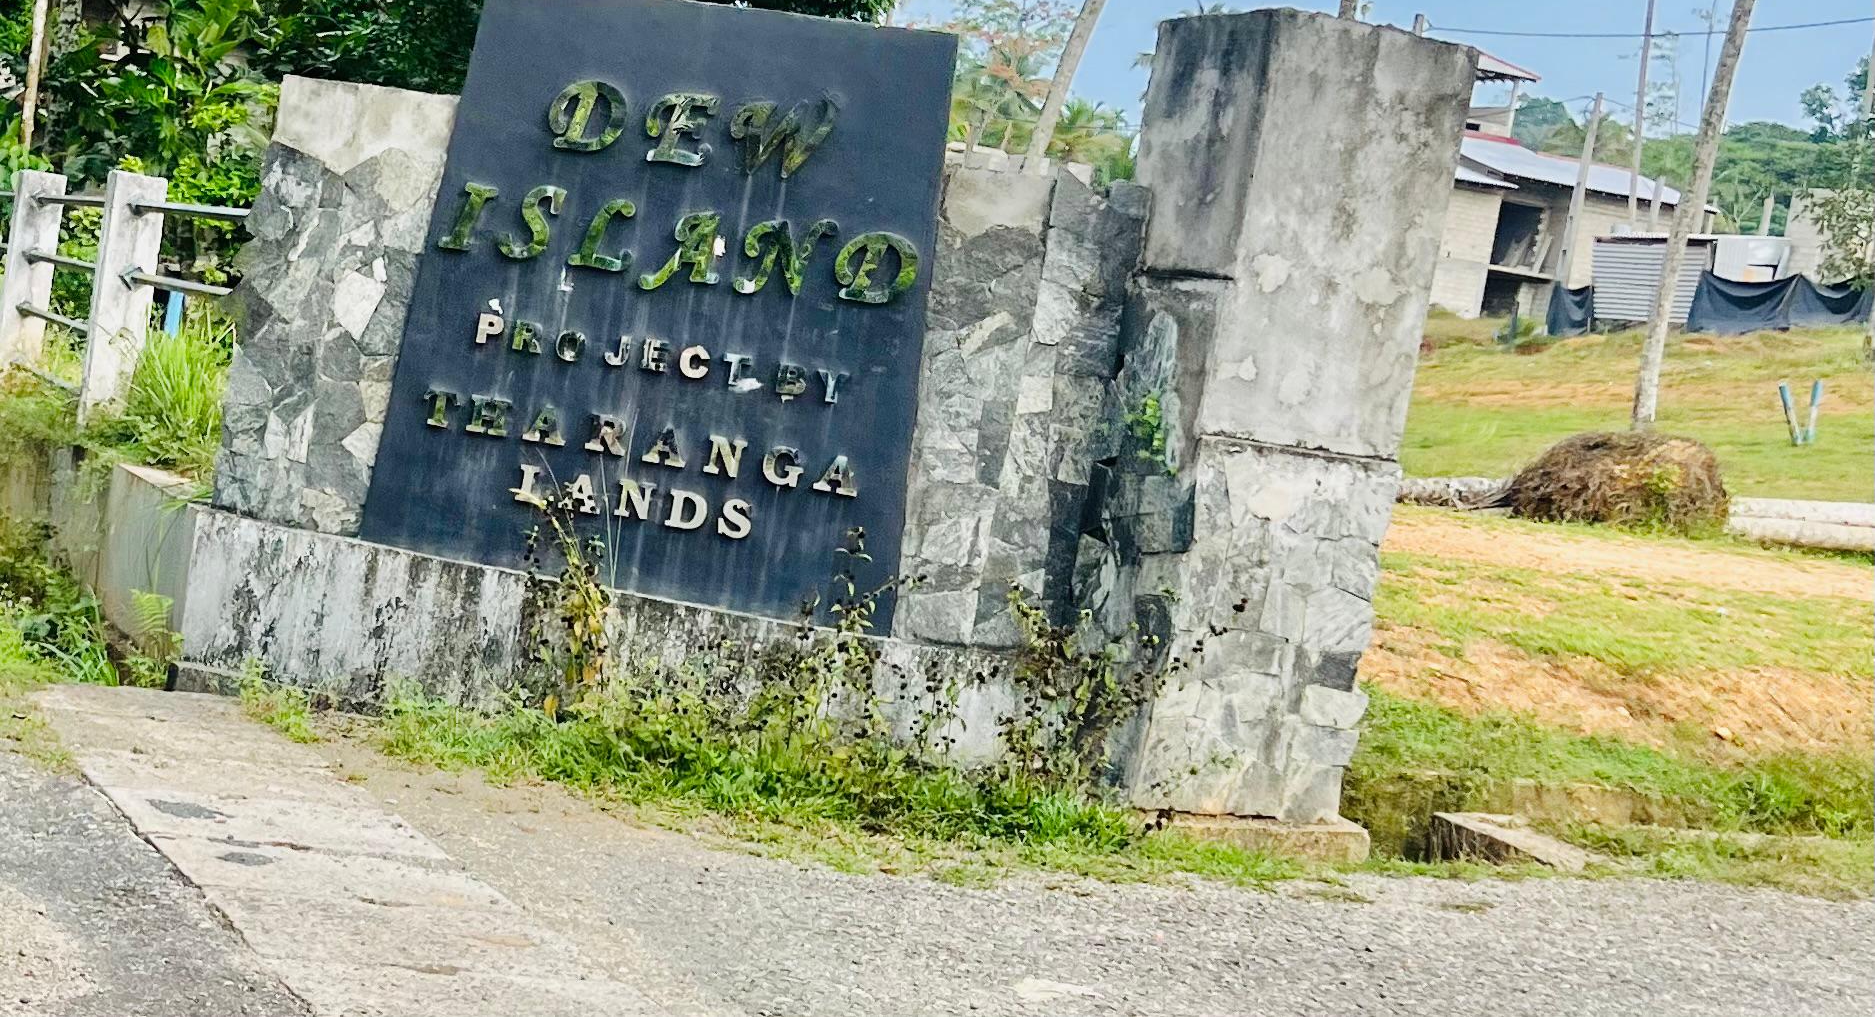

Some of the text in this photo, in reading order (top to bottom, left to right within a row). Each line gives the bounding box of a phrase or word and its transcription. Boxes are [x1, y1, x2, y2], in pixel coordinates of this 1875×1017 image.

[548, 80, 840, 179] DEW
[437, 181, 919, 303] ISLAND
[474, 312, 850, 404] PROJECT BY
[423, 387, 858, 497] THARANGA
[513, 463, 752, 539] LANDS
